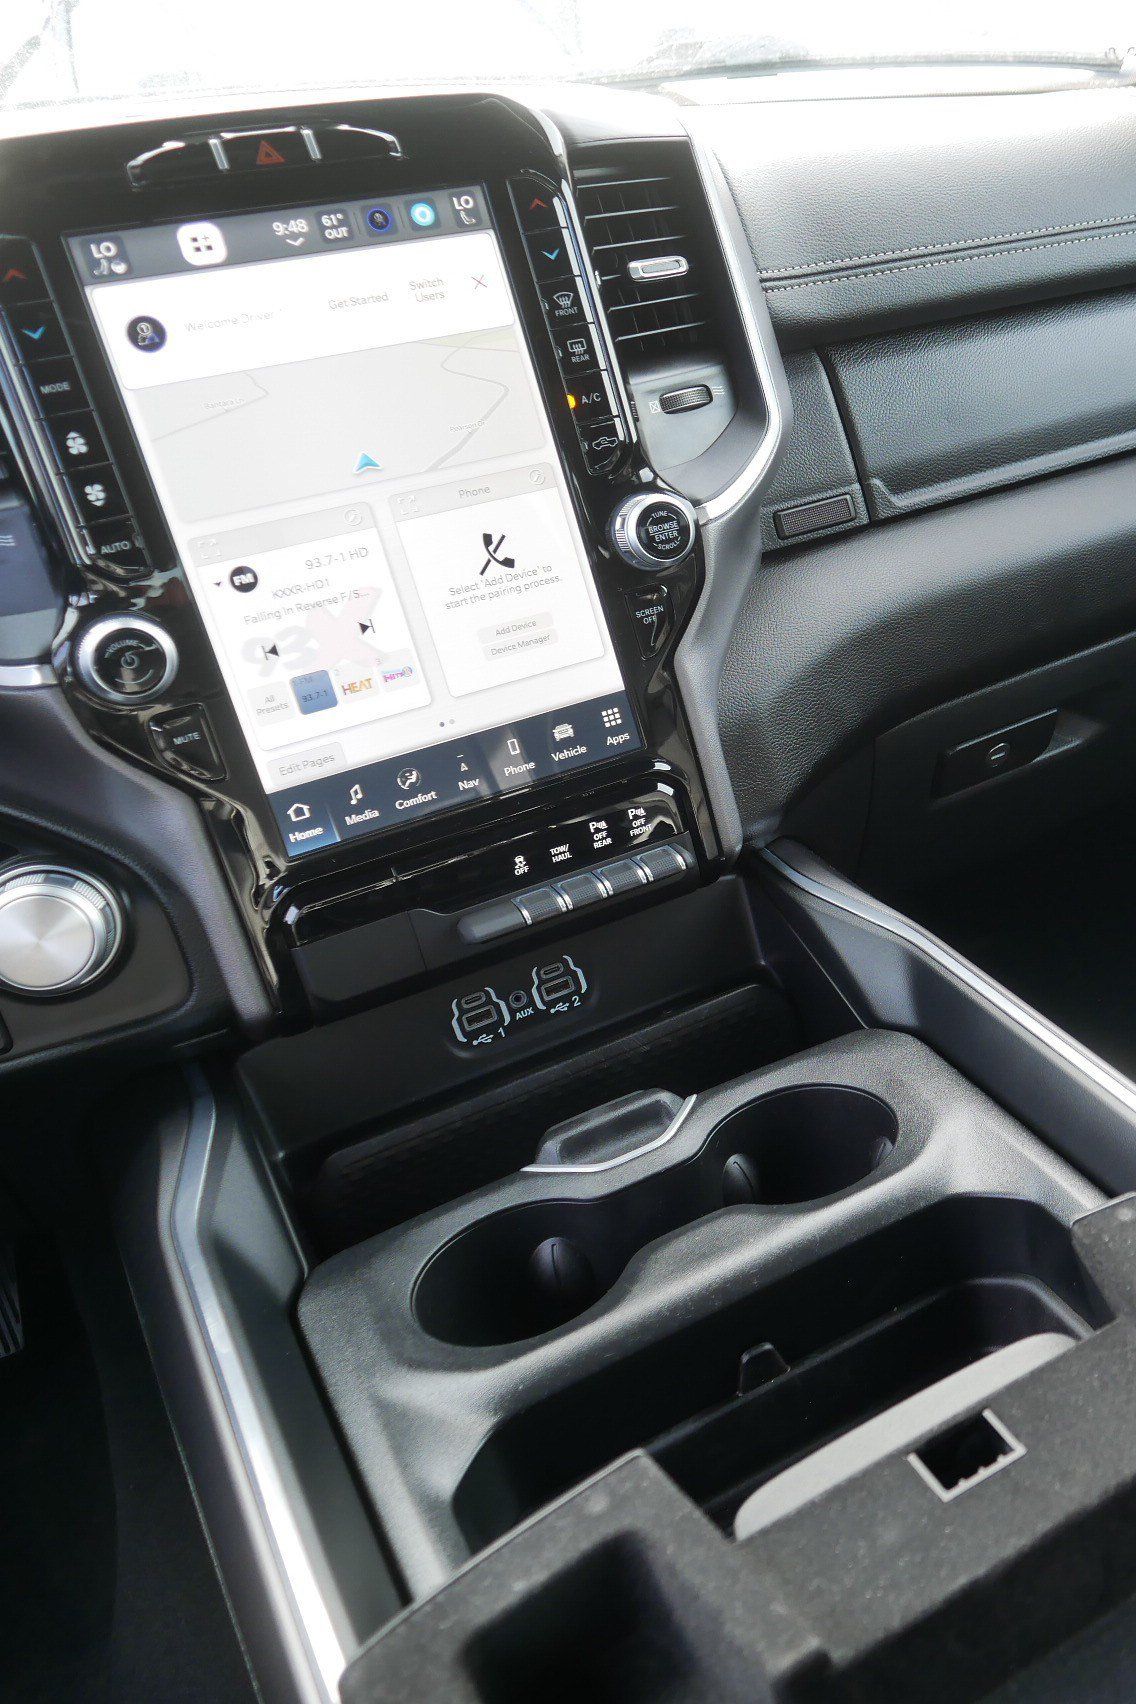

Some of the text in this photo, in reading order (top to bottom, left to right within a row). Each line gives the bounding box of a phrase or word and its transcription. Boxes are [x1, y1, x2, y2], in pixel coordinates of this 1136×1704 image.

[452, 195, 475, 212] LO
[272, 219, 309, 236] 9:48
[324, 226, 349, 240] OUT
[90, 241, 119, 259] LO
[408, 277, 445, 291] Switch
[328, 292, 389, 311] Get Started
[415, 290, 445, 302] Users
[554, 306, 579, 317] FRONT
[570, 353, 590, 364] REAR
[40, 381, 71, 394] MODE
[581, 392, 601, 405] A/C
[458, 484, 491, 499] Phone
[652, 510, 668, 519] TUNE
[648, 520, 679, 533] BROWSE
[654, 530, 679, 542] ENTER
[100, 540, 130, 555] AUTO
[657, 540, 679, 550] SCROLL
[348, 547, 369, 560] HD
[233, 574, 256, 586] FM
[448, 581, 479, 596] Select
[541, 564, 553, 574] to
[296, 595, 339, 612] Reverse
[445, 597, 469, 610] start
[469, 591, 486, 603] the
[488, 584, 522, 601] pairing
[635, 605, 664, 619] SCREEN
[643, 614, 657, 625] OFF
[495, 619, 537, 636] Add Device
[107, 640, 139, 655] VOLUME
[490, 634, 551, 656] Device Manager
[341, 678, 373, 696] HEAT
[172, 731, 200, 745] MUTE
[605, 732, 630, 746] Apps
[550, 744, 587, 762] Vehicle
[278, 754, 335, 777] Edit Pages
[503, 761, 536, 777] Phone
[458, 778, 480, 791] Nav
[395, 790, 438, 810] Comfort
[344, 809, 380, 826] Media
[632, 818, 646, 828] OFF
[288, 825, 325, 843] Home
[593, 831, 608, 841] OFF
[629, 823, 652, 837] FRONT
[550, 844, 569, 856] TOW/
[593, 837, 612, 849] REAR
[552, 852, 572, 863] HAUL
[514, 866, 530, 876] OFF
[571, 995, 582, 1007] 2
[515, 1006, 534, 1021] AUX
[498, 1027, 506, 1038] 1
